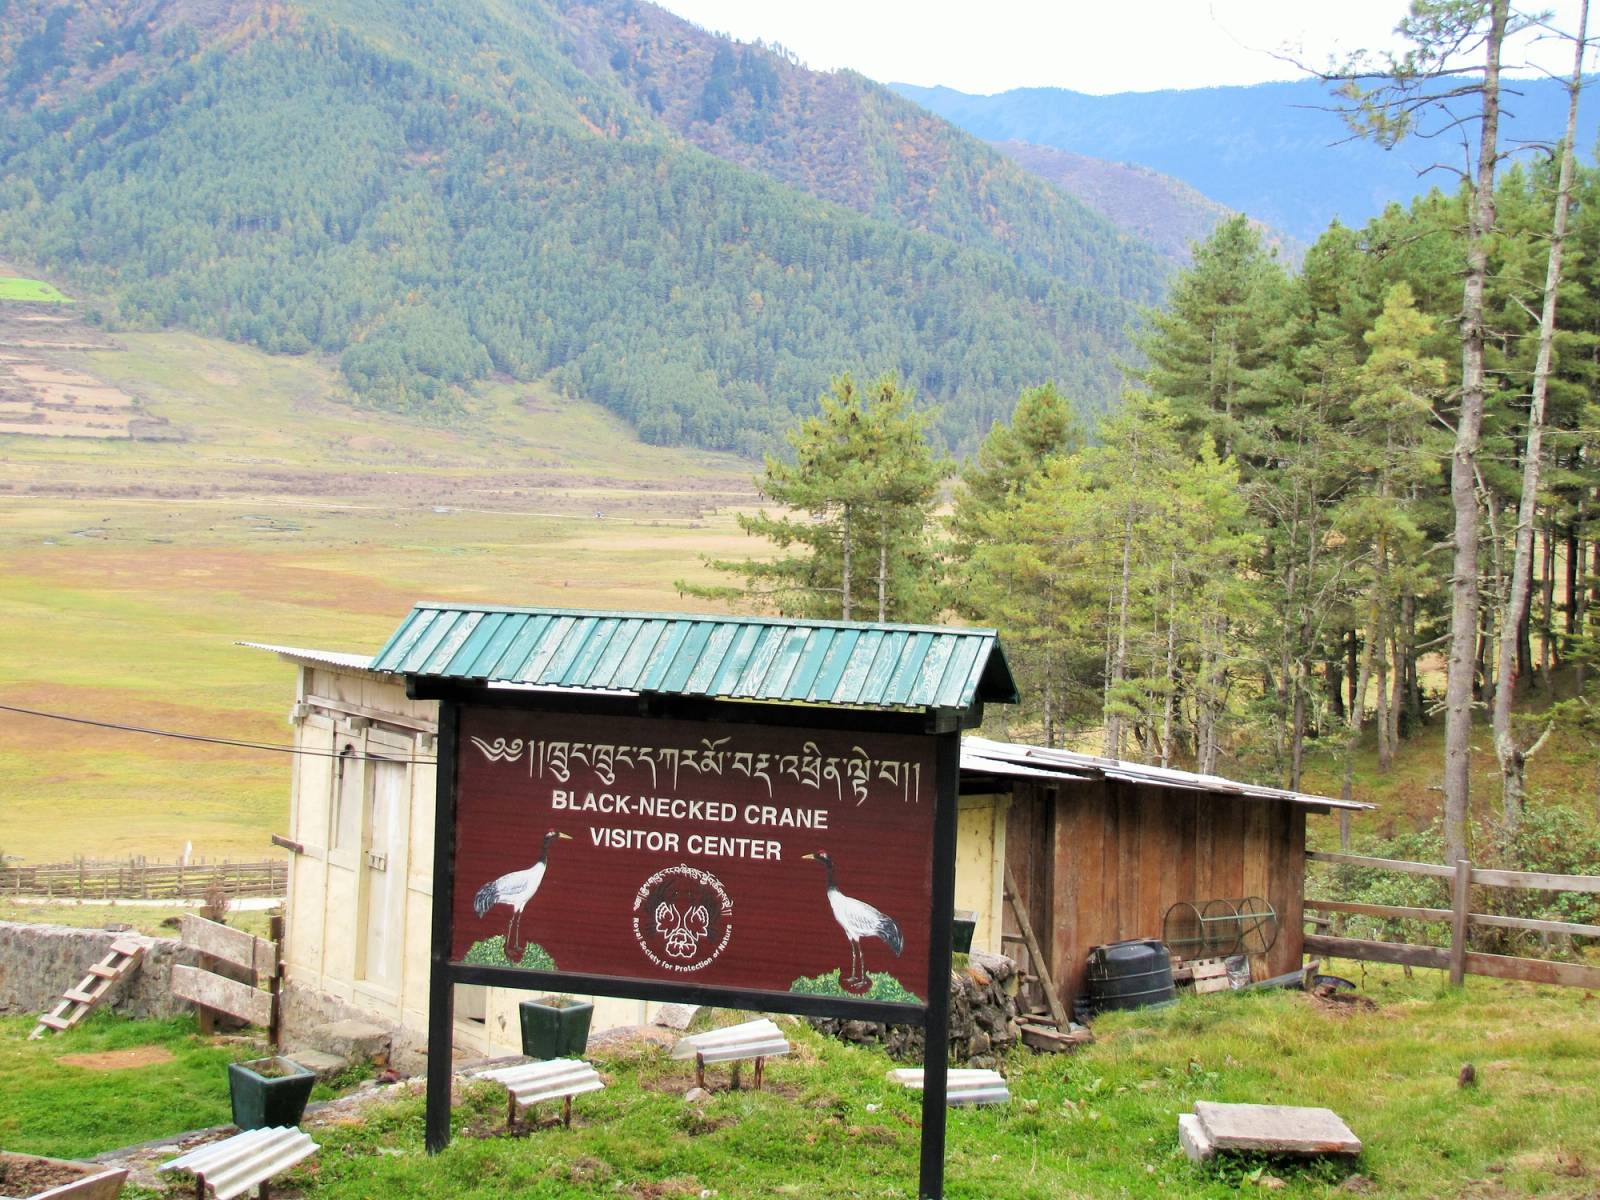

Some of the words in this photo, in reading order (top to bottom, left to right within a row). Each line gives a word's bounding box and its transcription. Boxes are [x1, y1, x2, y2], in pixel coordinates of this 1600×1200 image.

[552, 790, 736, 822] BLACK-NECKED
[744, 805, 828, 829] CRANE
[590, 827, 679, 852] VISITOR
[687, 835, 781, 860] CENTER
[633, 918, 643, 939] Royal
[640, 941, 661, 965] Society
[662, 961, 673, 970] for
[675, 957, 712, 972] Protection
[713, 950, 719, 958] of
[718, 925, 732, 951] Nature
